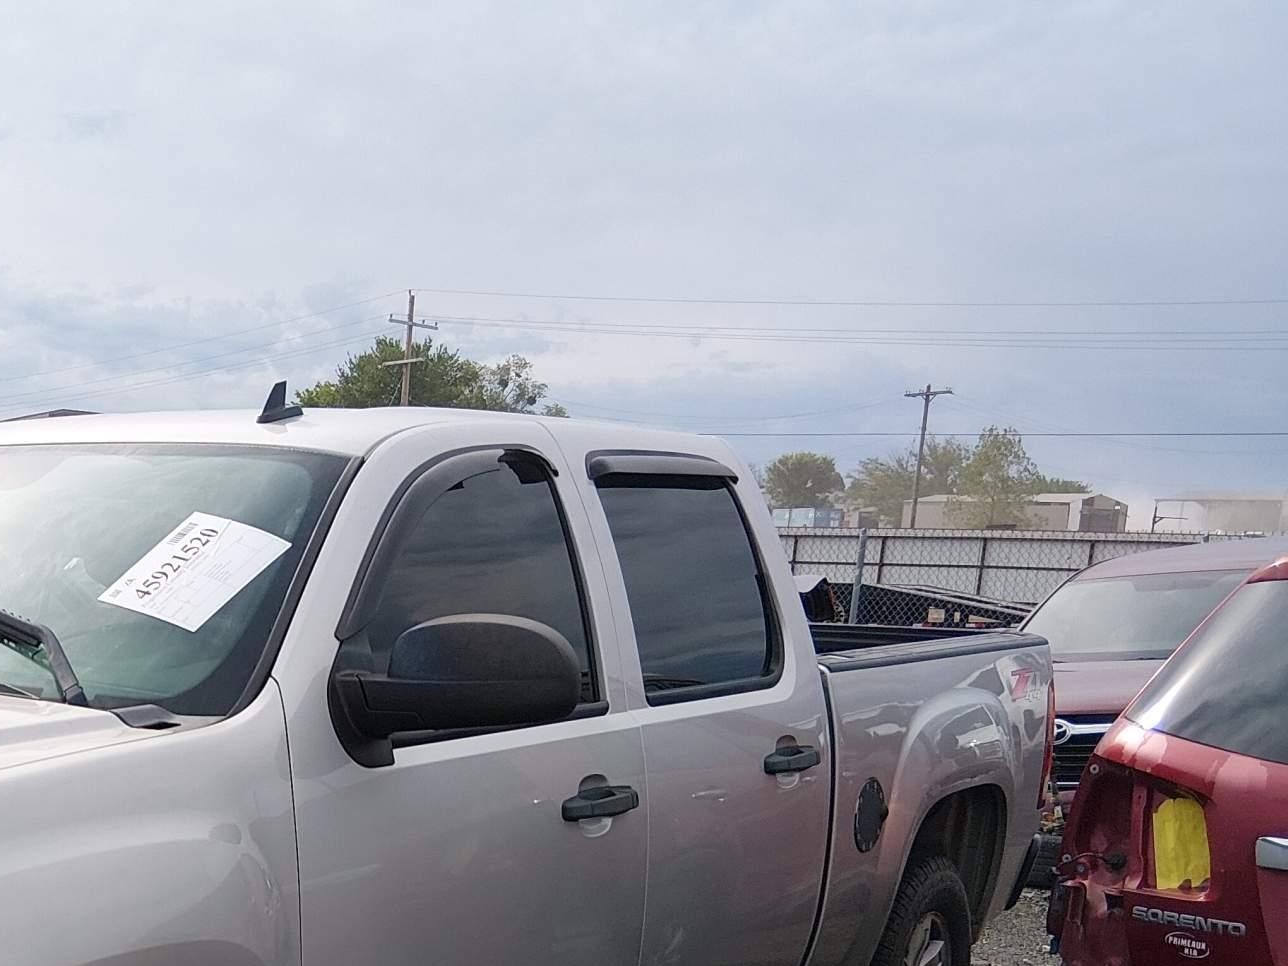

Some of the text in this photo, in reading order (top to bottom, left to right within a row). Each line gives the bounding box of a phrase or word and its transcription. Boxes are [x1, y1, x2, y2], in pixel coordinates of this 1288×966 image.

[135, 528, 219, 600] 45921520
[1132, 905, 1247, 937] SORENTO
[1168, 936, 1206, 950] PRIMEAUX
[1184, 947, 1198, 957] KIA
